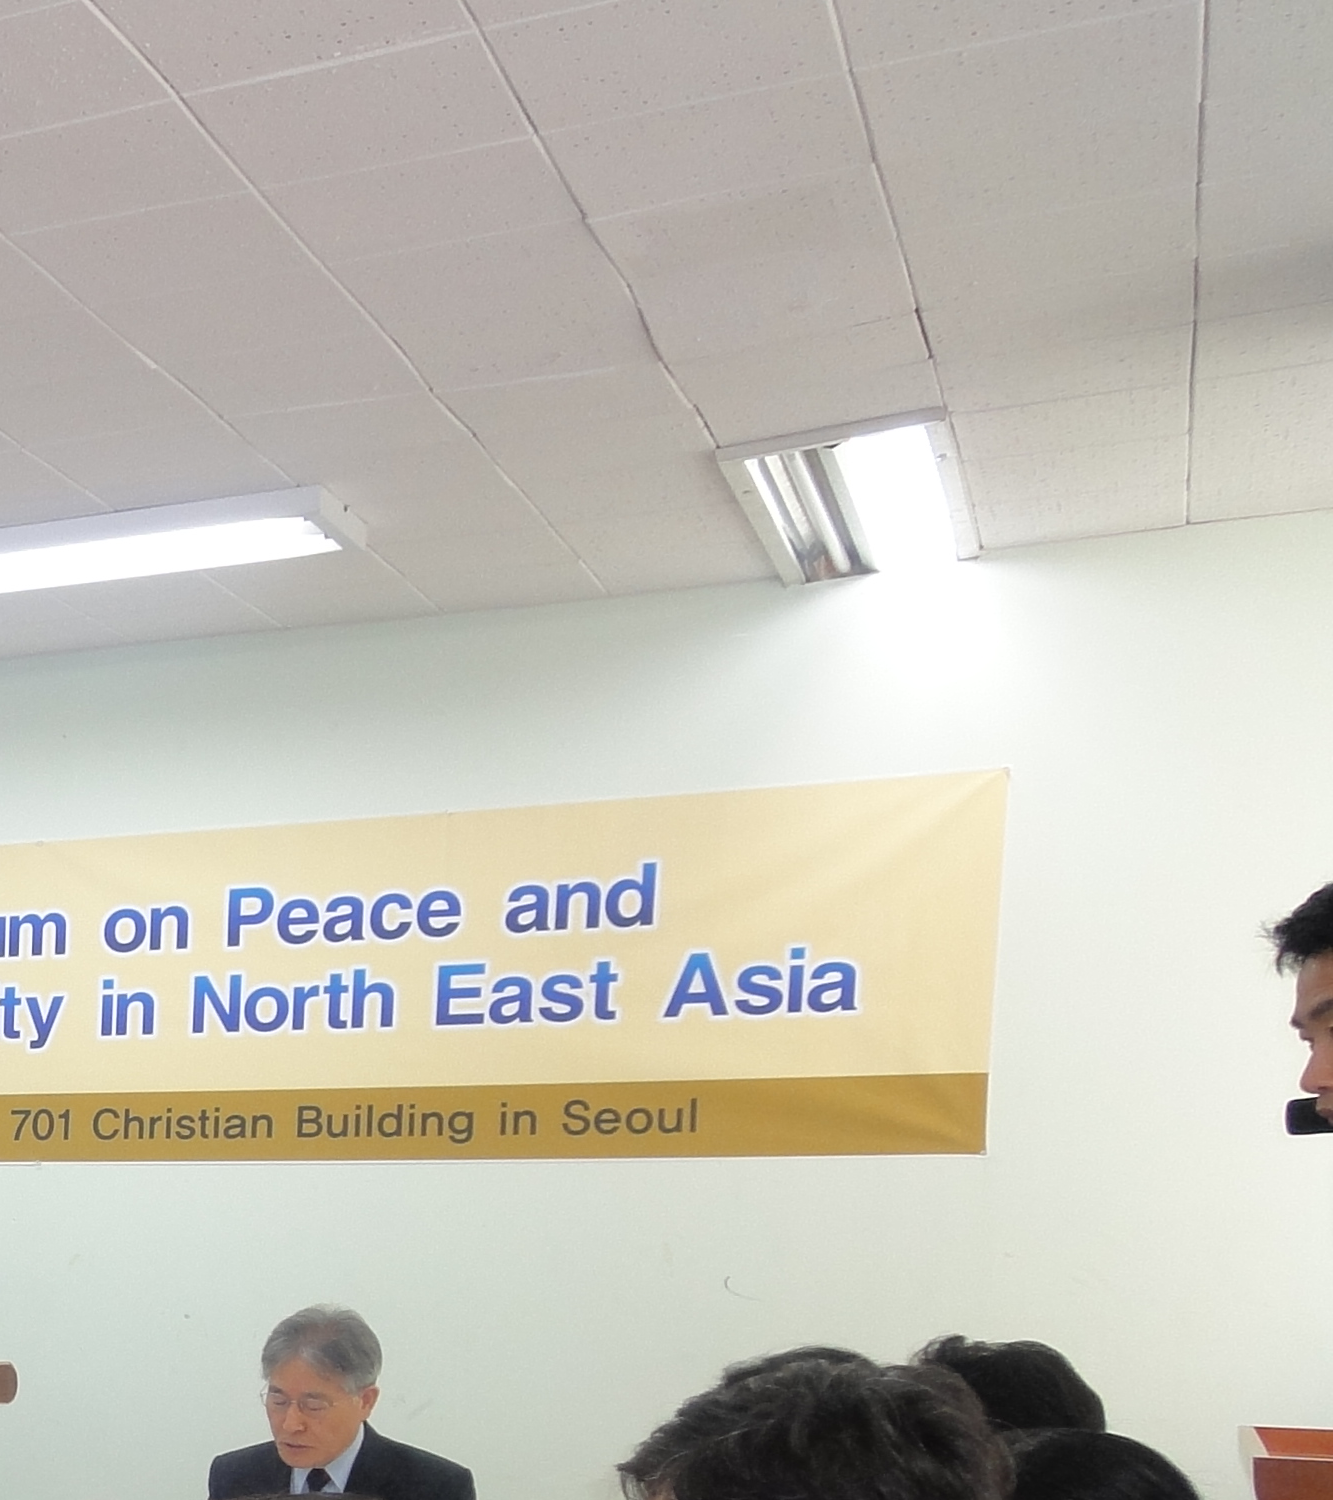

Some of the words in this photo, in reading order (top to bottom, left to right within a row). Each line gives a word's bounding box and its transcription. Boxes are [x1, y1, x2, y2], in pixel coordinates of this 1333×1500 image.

[103, 904, 189, 953] on
[226, 886, 462, 948] Peace
[504, 861, 658, 934] and
[100, 978, 155, 1036] in
[191, 968, 395, 1034] North
[435, 960, 619, 1027] East
[662, 946, 858, 1018] Asia
[9, 1108, 71, 1142] 701
[92, 1107, 274, 1141] Christian
[295, 1103, 475, 1145] Building
[499, 1101, 538, 1137] in
[561, 1098, 699, 1136] Seoul
